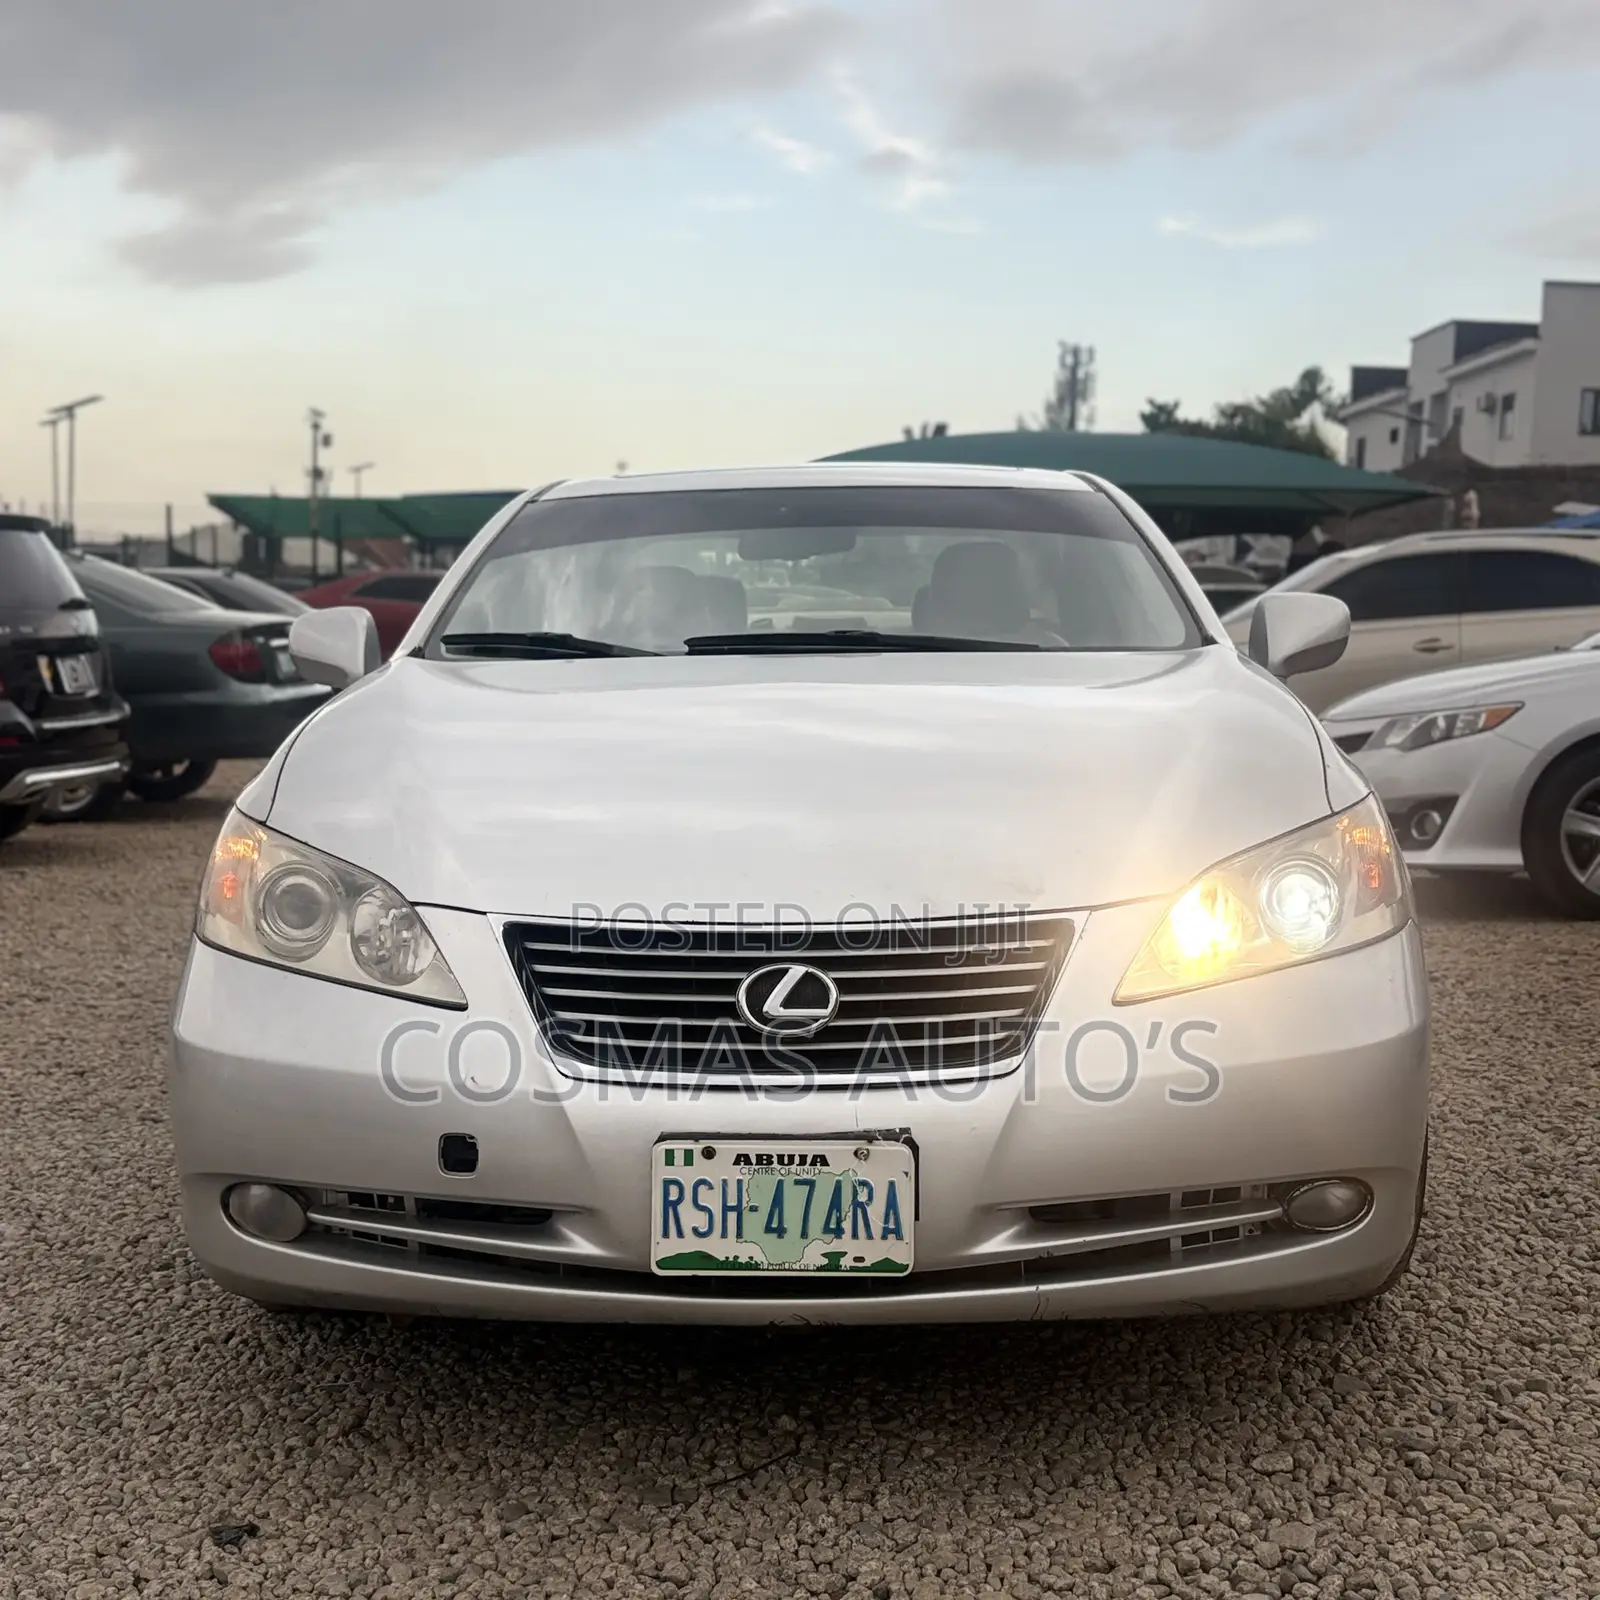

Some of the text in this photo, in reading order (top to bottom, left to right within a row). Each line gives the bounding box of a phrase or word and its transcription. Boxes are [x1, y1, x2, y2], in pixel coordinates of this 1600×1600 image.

[732, 1153, 830, 1167] ABUJA
[739, 1166, 823, 1176] CENTRE OF UNITY
[661, 1177, 904, 1241] RSH-474RA
